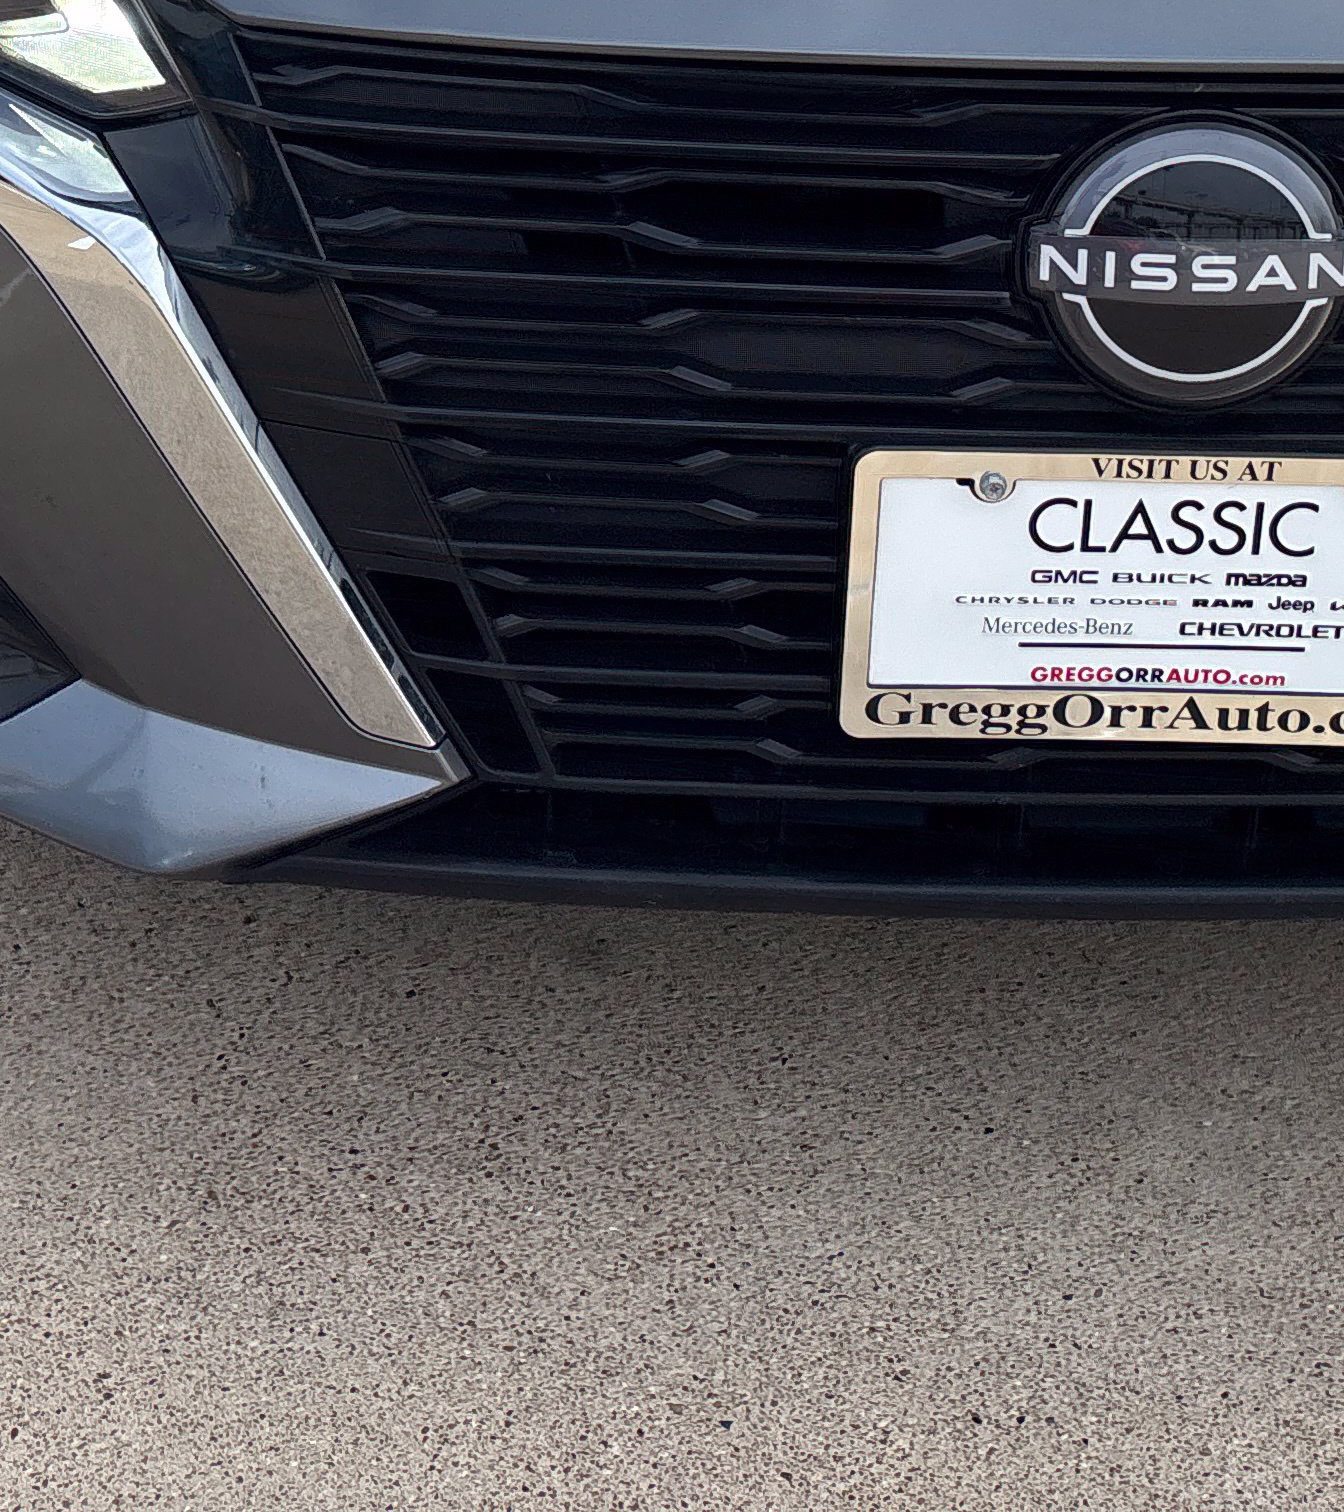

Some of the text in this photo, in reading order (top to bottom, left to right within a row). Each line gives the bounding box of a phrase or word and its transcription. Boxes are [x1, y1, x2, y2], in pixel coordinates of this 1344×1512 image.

[1091, 457, 1282, 482] VISIT US AT
[1027, 497, 1320, 558] CLASSIC
[1030, 569, 1307, 588] GMC BUICK mazda
[955, 595, 1076, 605] CHRYSLER
[1090, 597, 1178, 606] DODGE
[1192, 598, 1254, 608] RAM
[1267, 596, 1315, 613] Jeep
[981, 616, 1134, 636] Mercedes-Benz
[1030, 666, 1286, 687] GREGGORRAUTO.com
